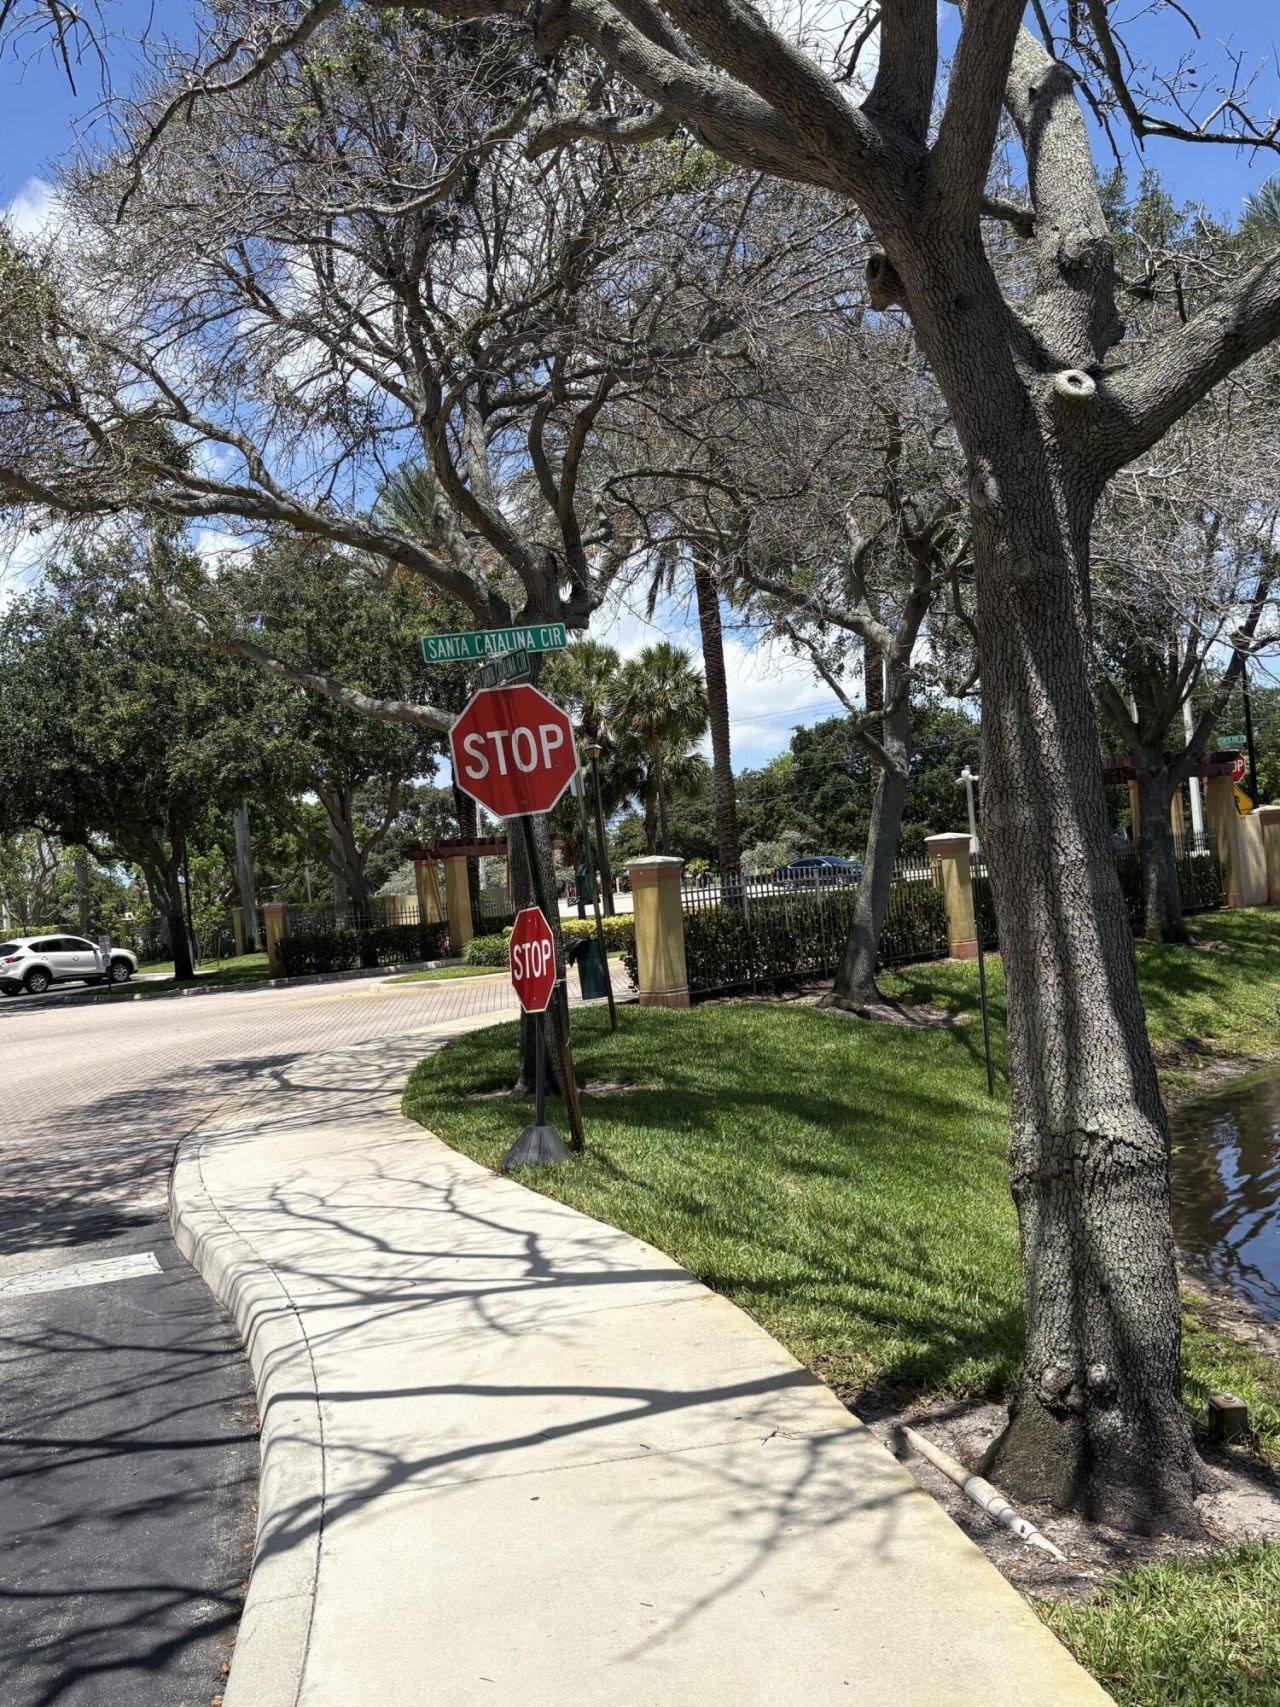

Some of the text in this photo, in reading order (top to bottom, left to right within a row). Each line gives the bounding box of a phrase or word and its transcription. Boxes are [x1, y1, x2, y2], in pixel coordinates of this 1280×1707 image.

[428, 627, 562, 659] SANTA CATALINA CIR
[463, 723, 564, 780] STOP
[1232, 759, 1244, 773] OP
[513, 938, 551, 981] STOP
